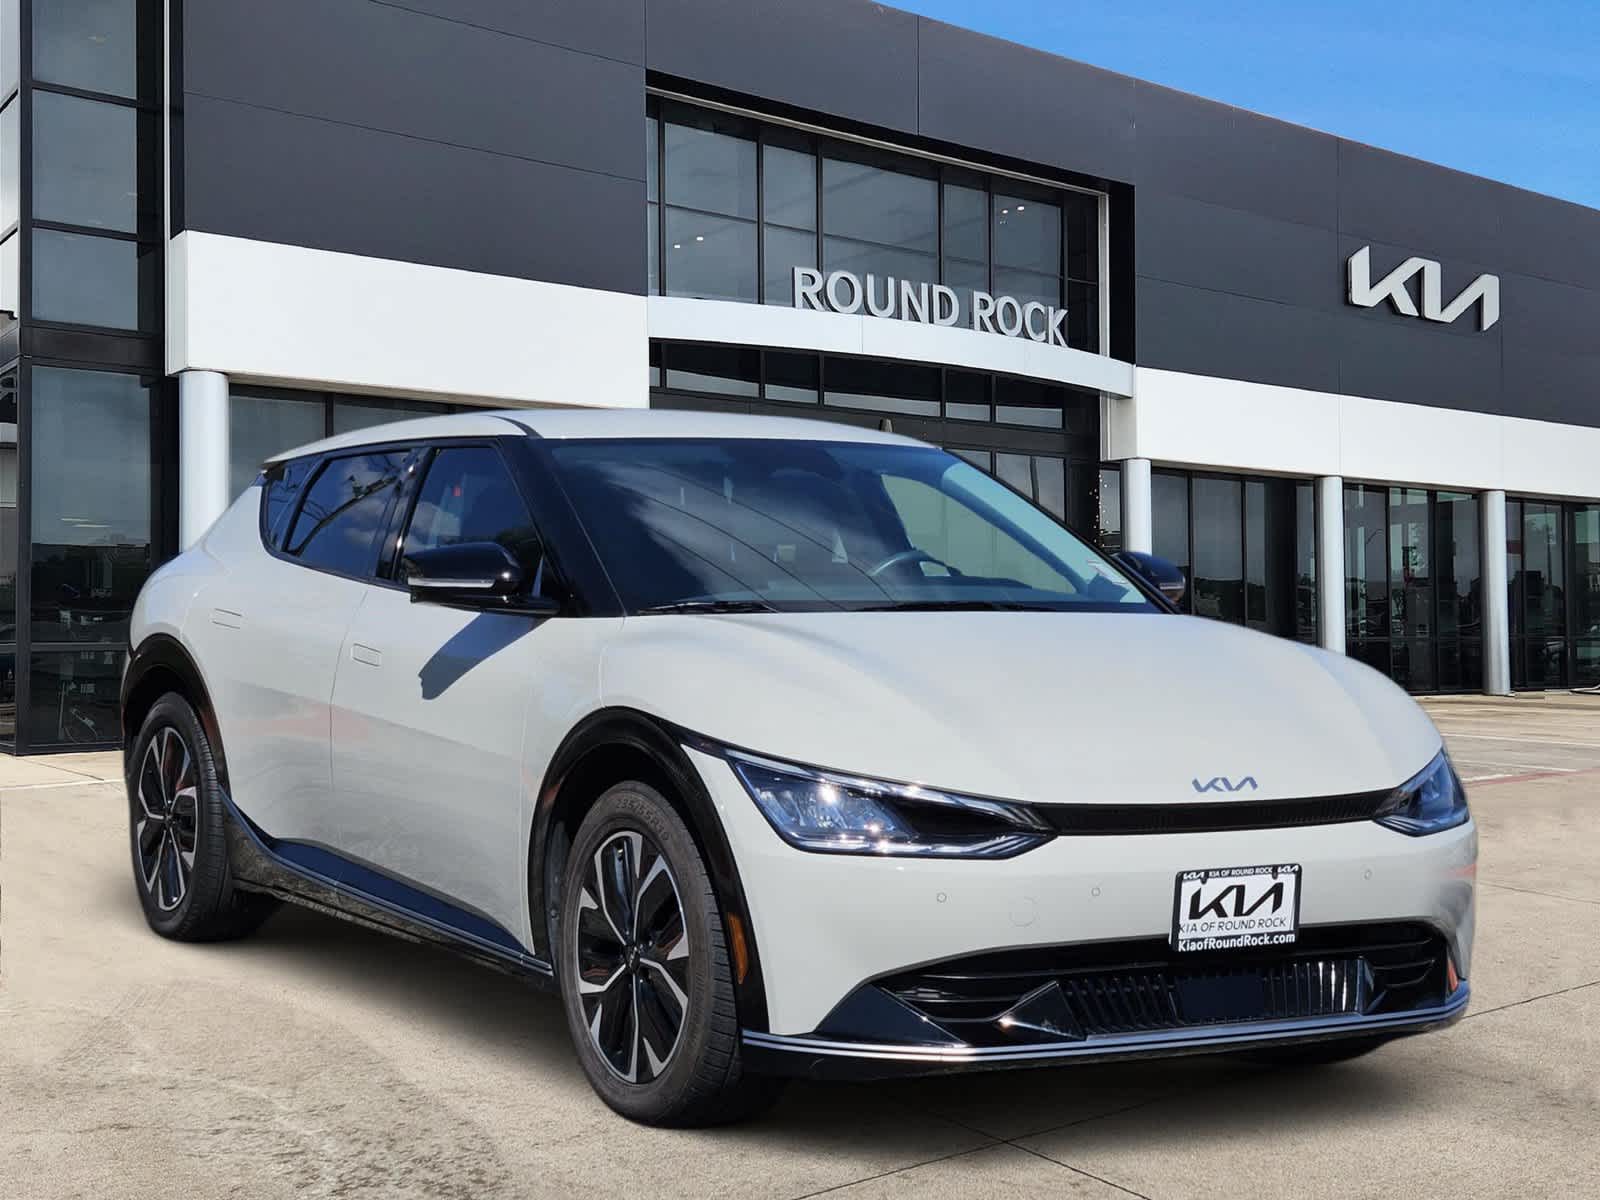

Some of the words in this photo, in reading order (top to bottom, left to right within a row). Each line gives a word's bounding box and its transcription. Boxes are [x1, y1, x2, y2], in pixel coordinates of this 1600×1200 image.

[1348, 245, 1499, 331] KIA
[793, 266, 959, 326] ROUND
[971, 290, 1068, 348] ROCK
[1192, 776, 1258, 792] KIA
[1209, 870, 1220, 878] KIA
[1231, 868, 1254, 876] ROUND
[1255, 866, 1273, 874] ROCK
[1188, 882, 1284, 920] KIA
[1179, 923, 1197, 934] KIA
[1201, 921, 1215, 932] OF
[1217, 919, 1256, 931] ROUND
[1257, 917, 1287, 929] ROCK
[1178, 932, 1296, 952] KiaofRoundRock.com
